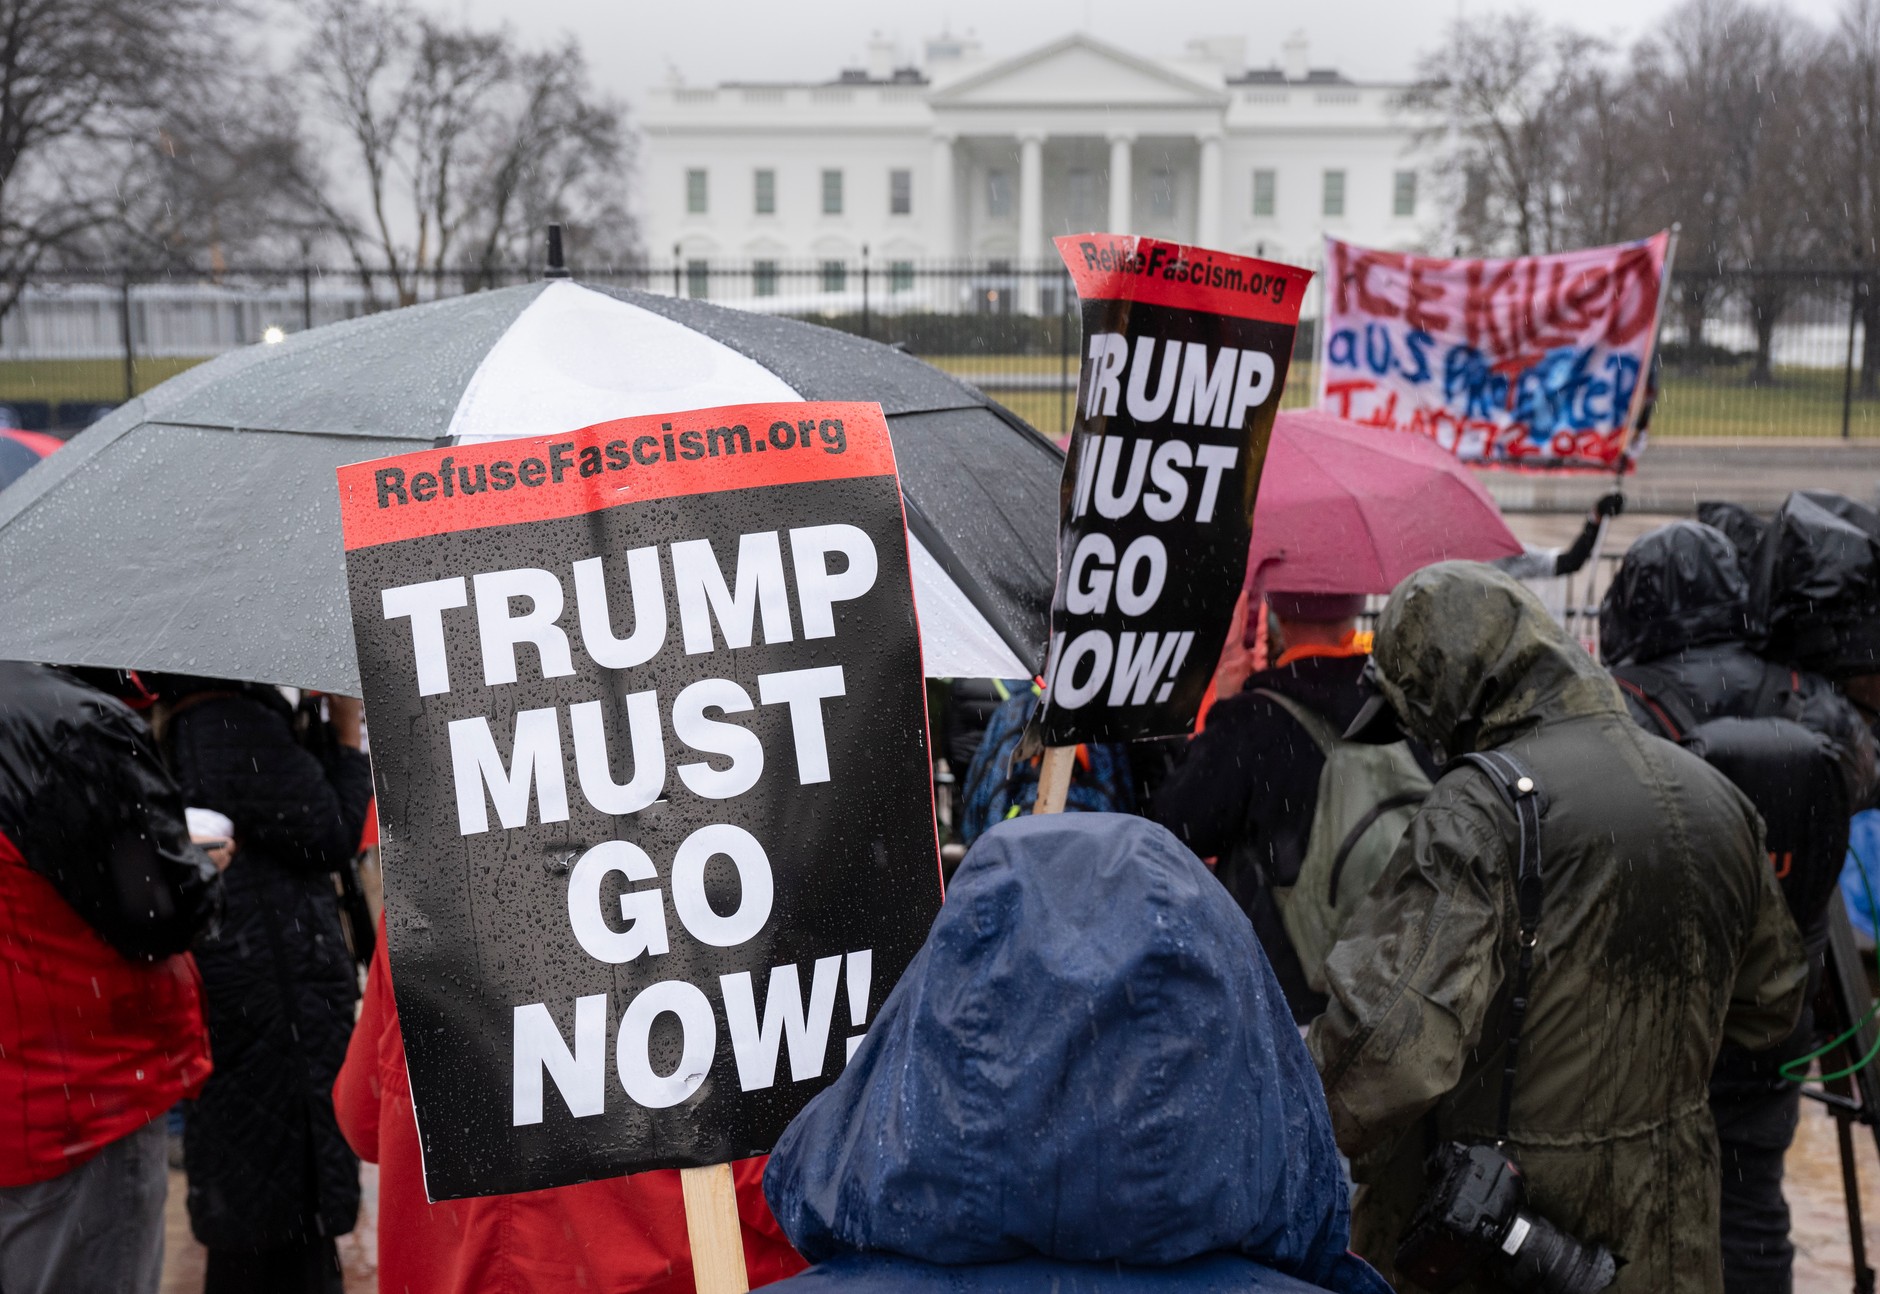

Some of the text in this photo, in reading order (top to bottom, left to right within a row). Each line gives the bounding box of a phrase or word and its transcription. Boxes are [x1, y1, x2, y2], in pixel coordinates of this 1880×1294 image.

[1080, 240, 1288, 305] RefuseFascism.org
[1335, 241, 1451, 332] ICE
[374, 416, 848, 509] RefuseFascism.org
[381, 523, 879, 698] TRUMP
[1066, 532, 1168, 617] GO
[448, 665, 847, 836] MUST
[567, 823, 774, 963] GO
[513, 949, 873, 1127] NOW!
